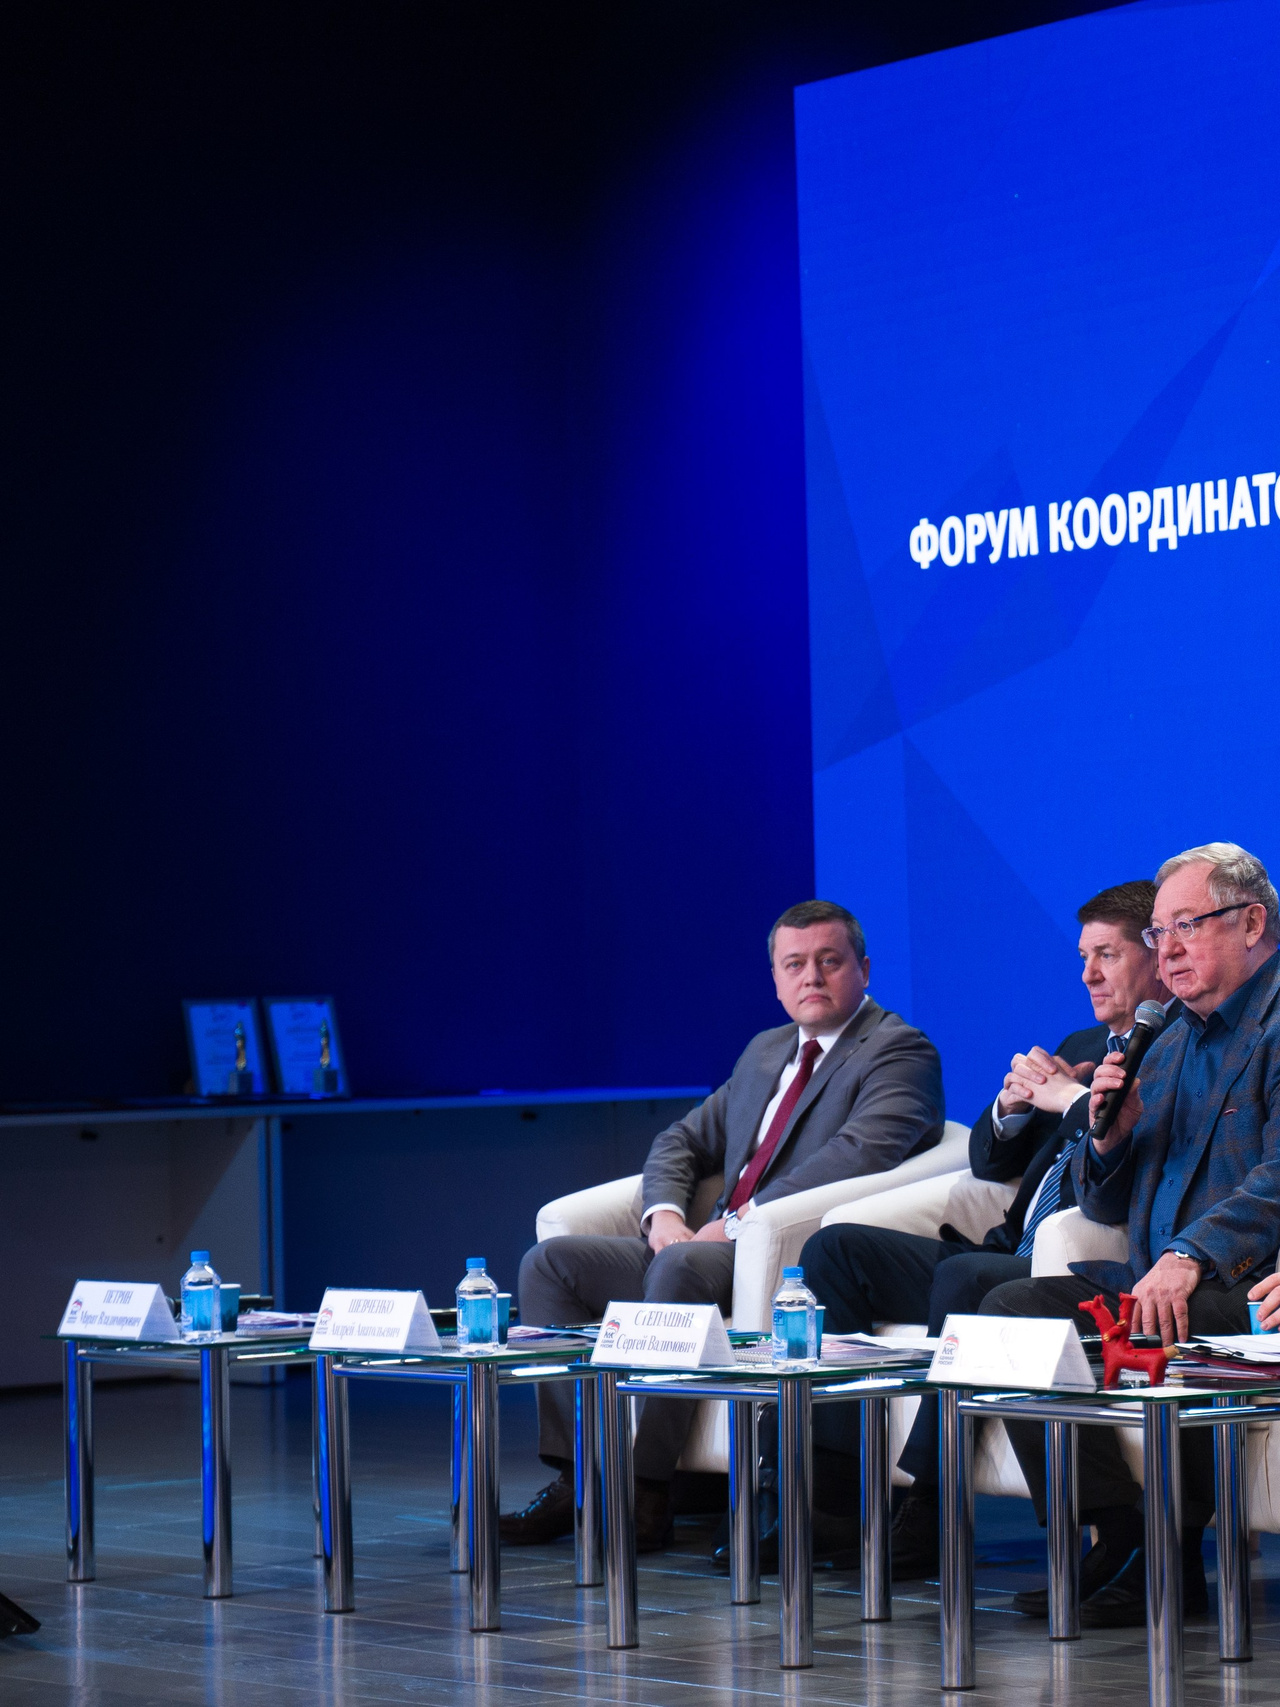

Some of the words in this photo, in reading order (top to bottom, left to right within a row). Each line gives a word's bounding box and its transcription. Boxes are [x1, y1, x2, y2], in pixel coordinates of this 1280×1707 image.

[908, 508, 1040, 570] ФОРУМ
[347, 1298, 395, 1315] ШЕВЧЕНКО
[616, 1332, 648, 1354] Сергей
[647, 1334, 697, 1353] Вадимович
